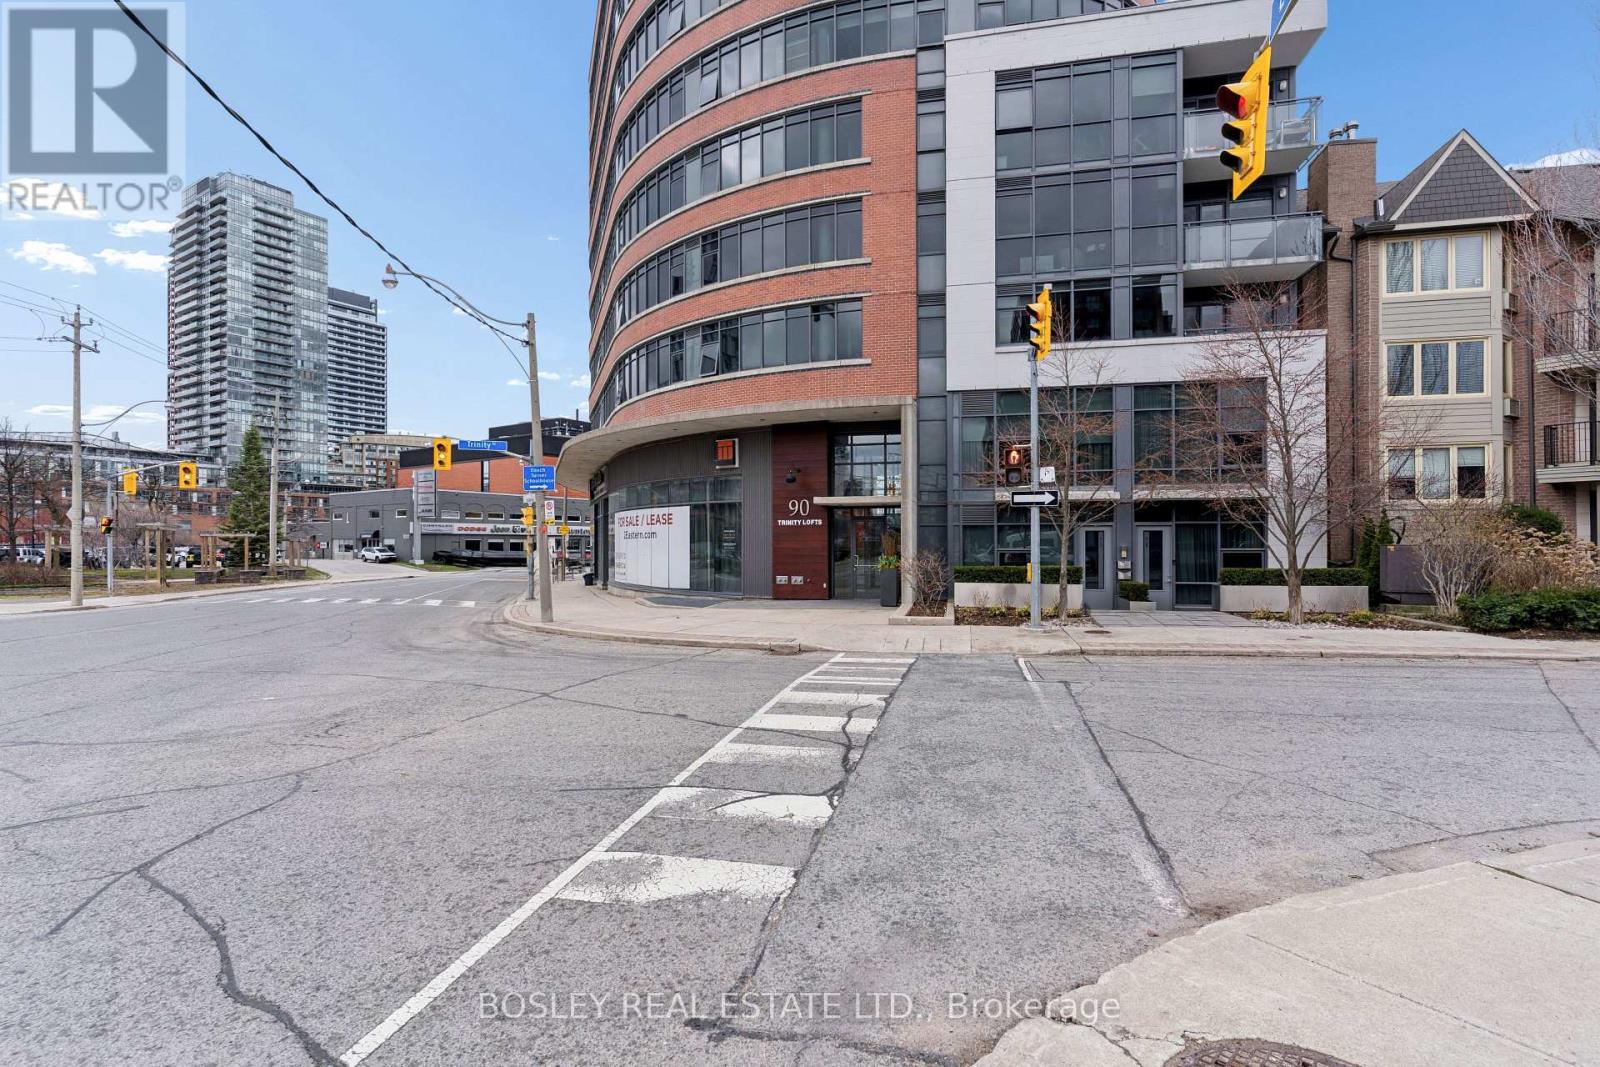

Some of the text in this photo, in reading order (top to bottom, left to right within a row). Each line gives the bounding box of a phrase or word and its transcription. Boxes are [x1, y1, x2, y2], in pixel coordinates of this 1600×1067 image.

[467, 440, 490, 449] Trinity
[788, 499, 810, 517] 90
[625, 515, 639, 527] SALE
[646, 513, 673, 526] LEASE
[490, 524, 510, 533] Jeep
